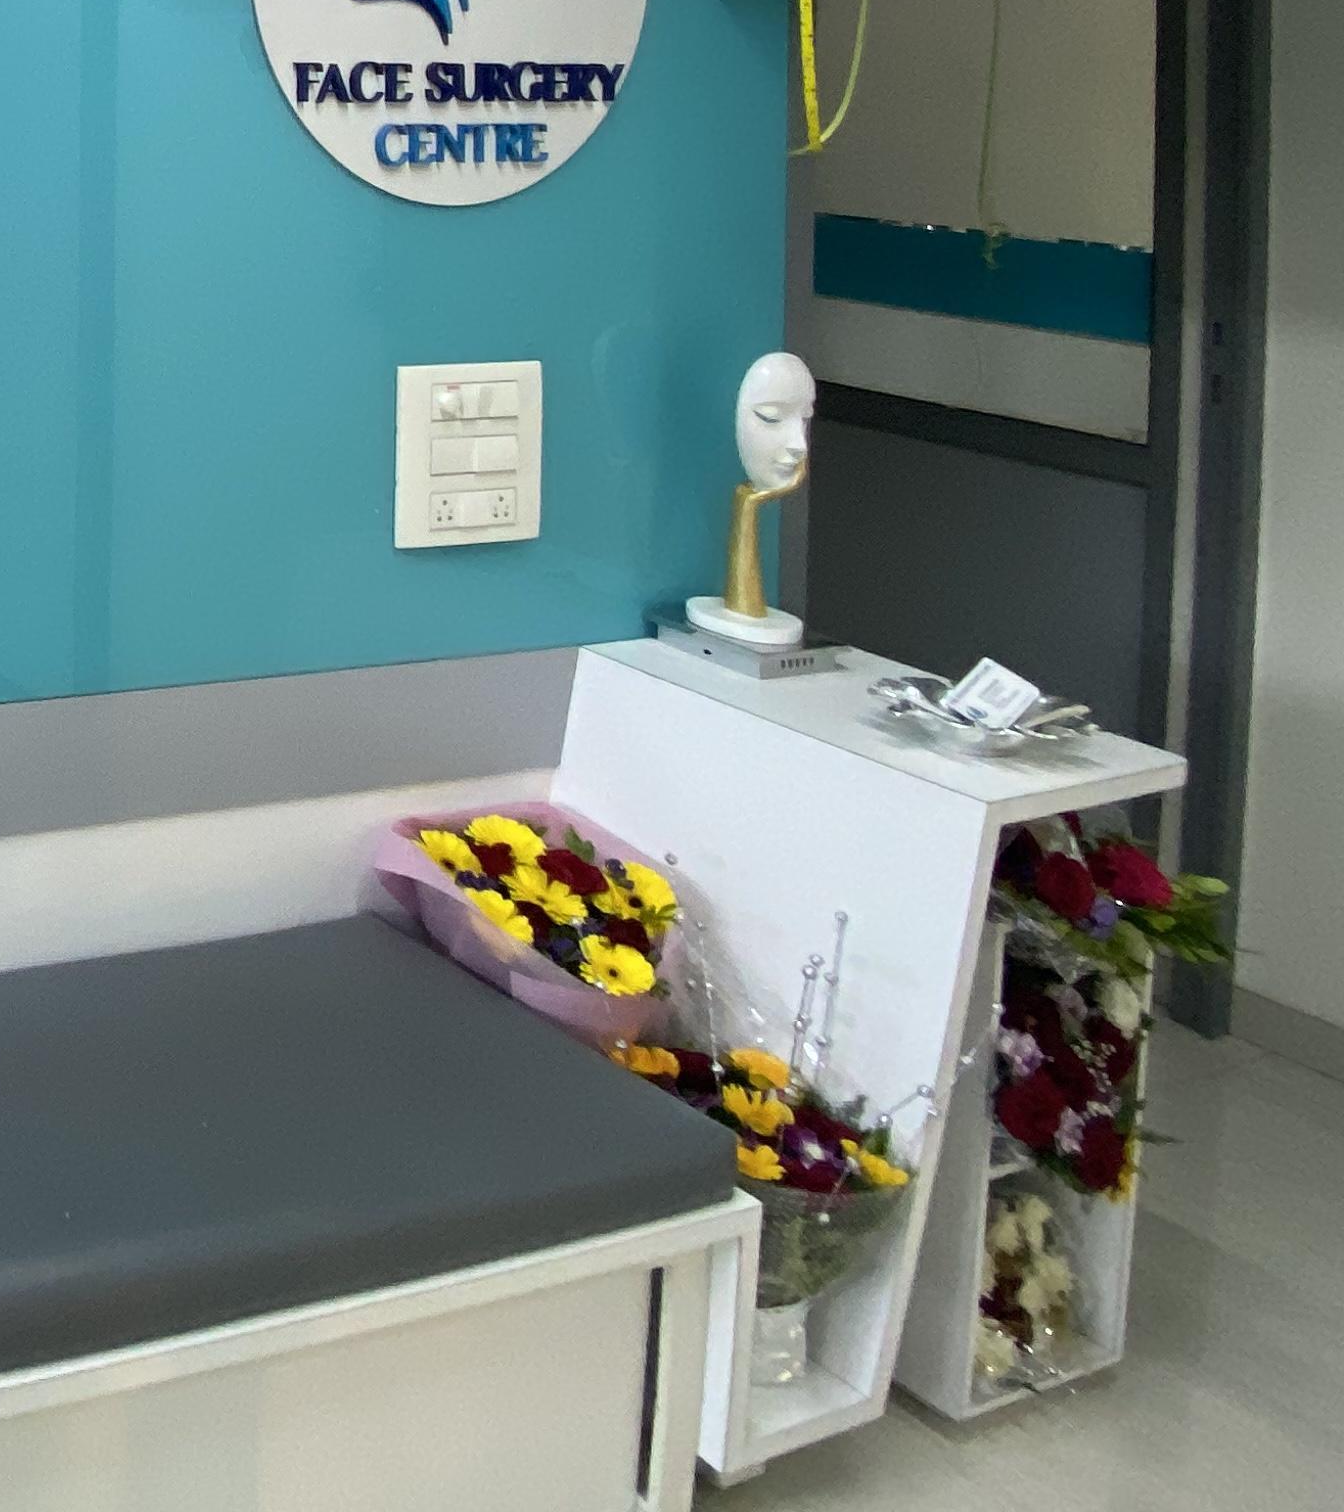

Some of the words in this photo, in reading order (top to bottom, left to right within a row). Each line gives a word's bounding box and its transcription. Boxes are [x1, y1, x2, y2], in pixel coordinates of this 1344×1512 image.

[292, 61, 414, 105] FACE
[425, 61, 625, 105] SURGERY
[374, 121, 550, 169] CENTRE
